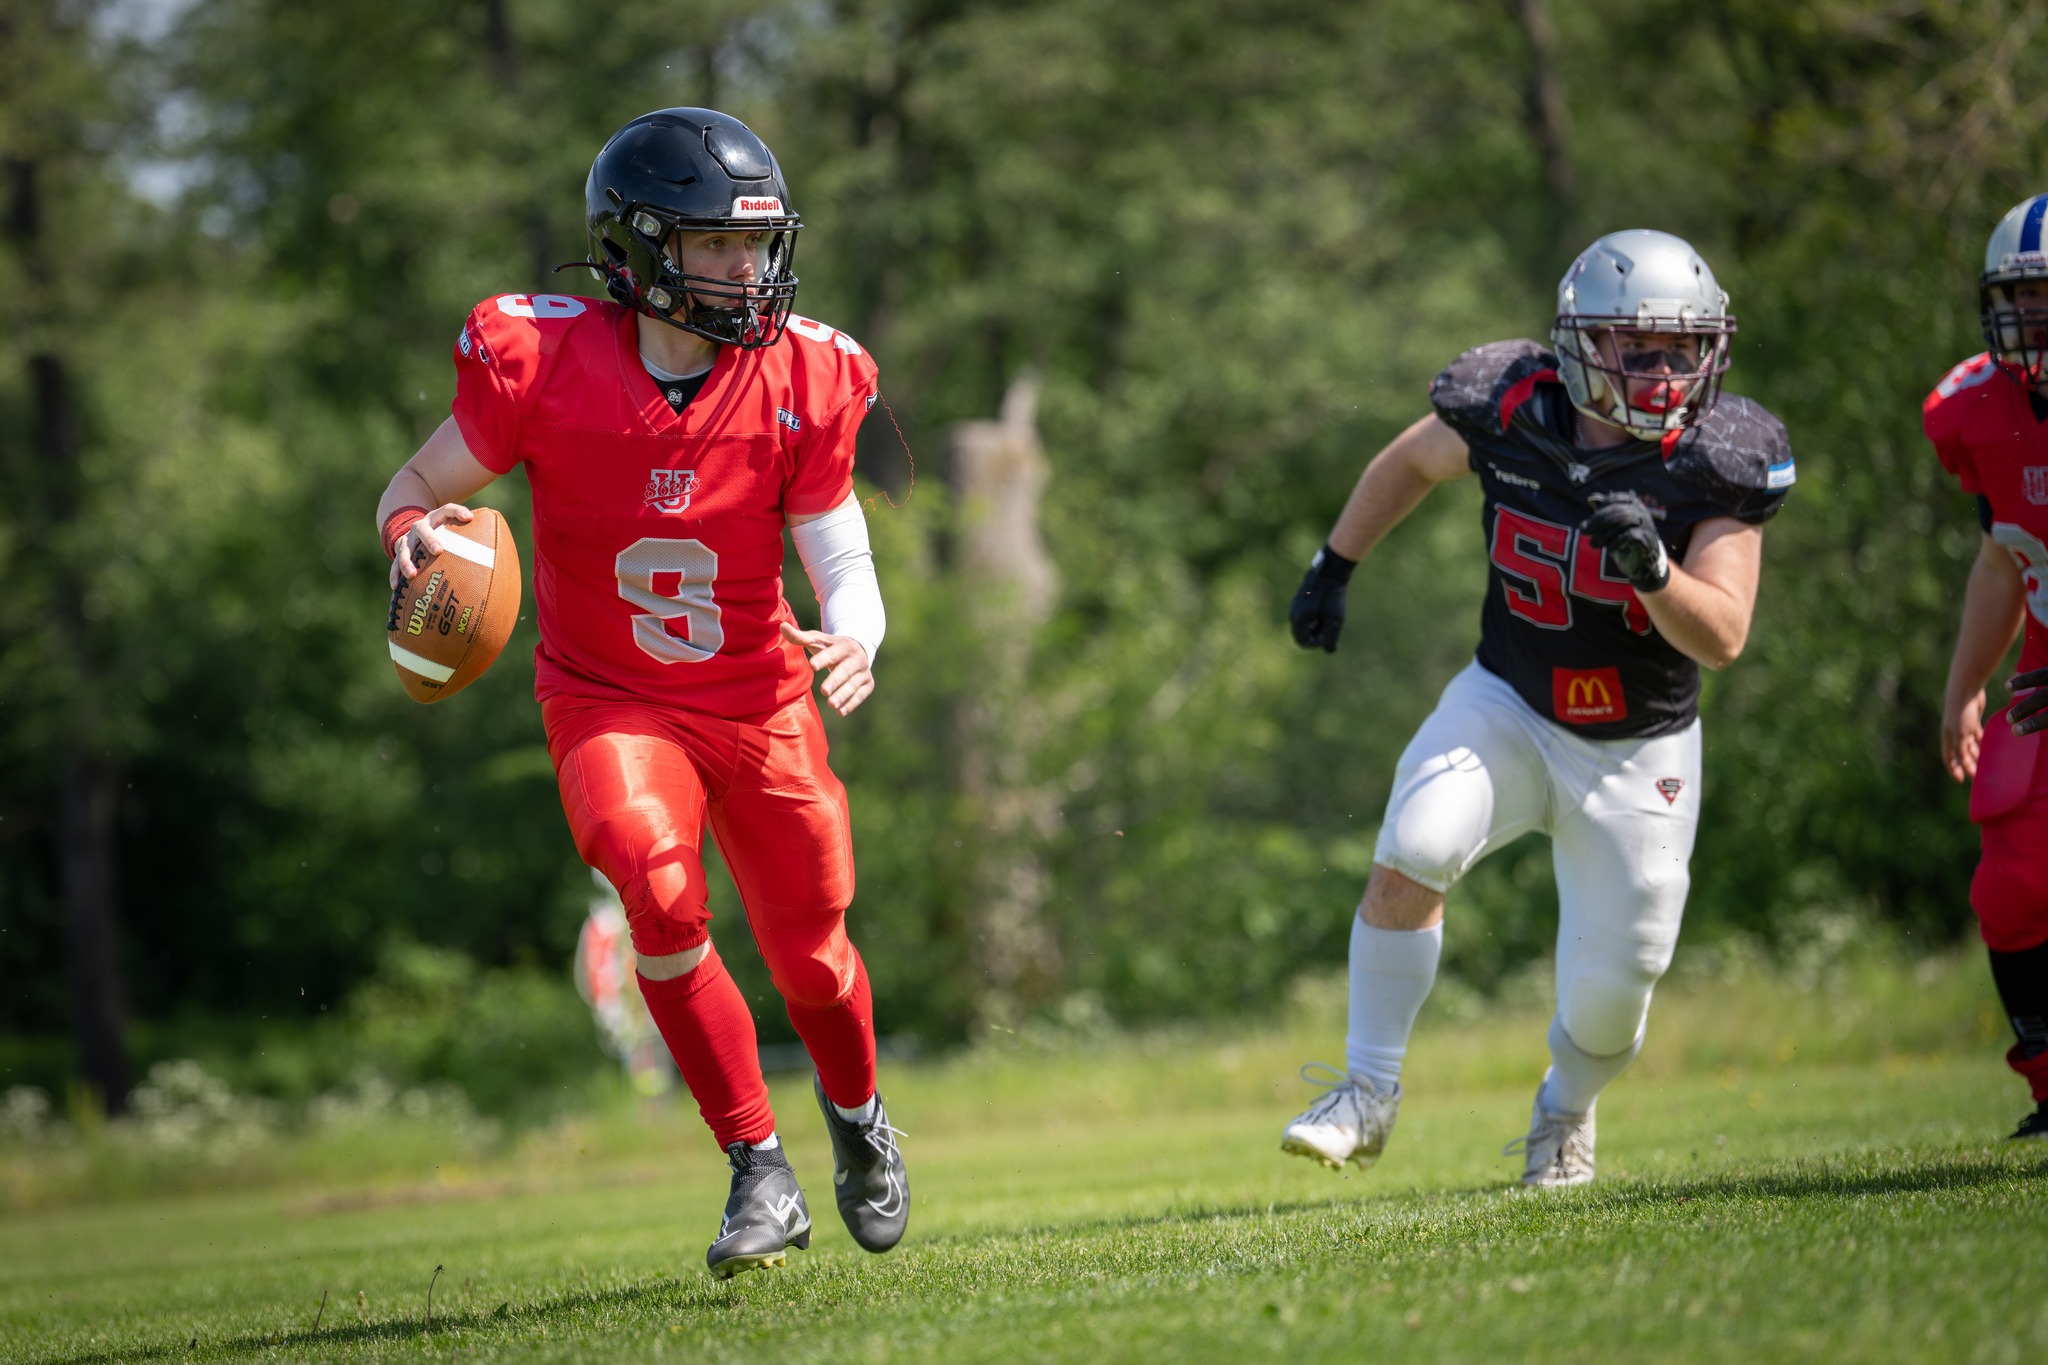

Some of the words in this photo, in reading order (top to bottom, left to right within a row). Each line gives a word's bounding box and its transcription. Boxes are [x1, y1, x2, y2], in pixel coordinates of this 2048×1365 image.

[740, 199, 780, 211] Riddell
[407, 571, 444, 636] Wilson
[438, 589, 460, 637] GST
[456, 606, 473, 634] NCAA
[615, 537, 724, 665] 9
